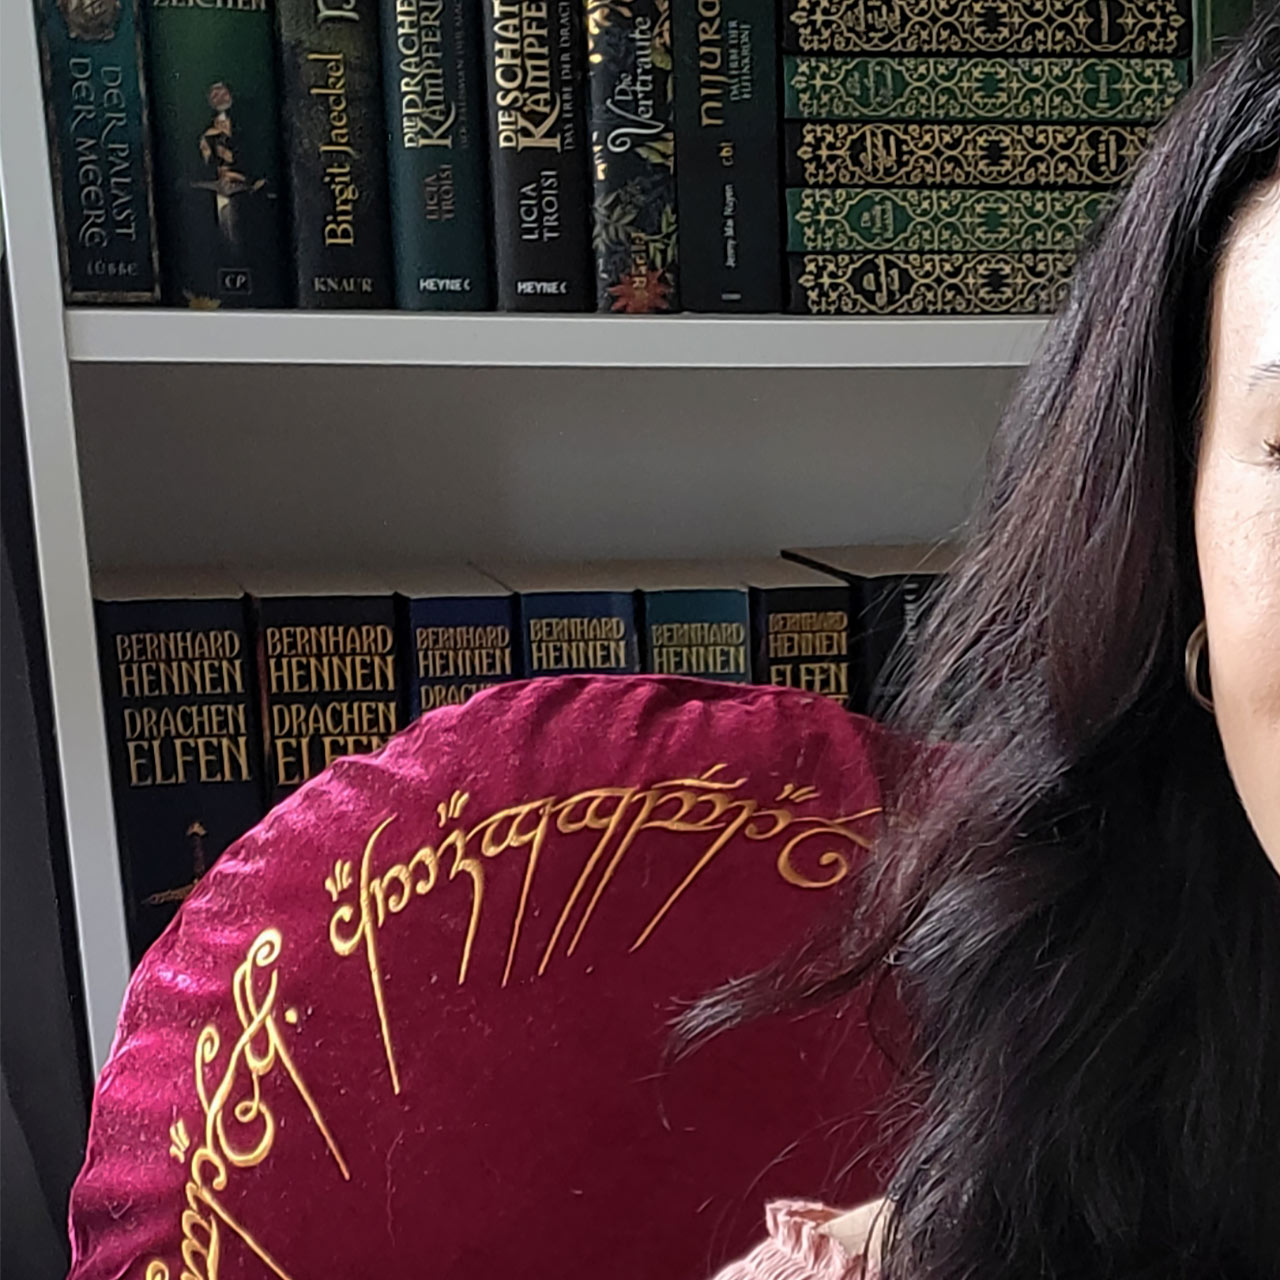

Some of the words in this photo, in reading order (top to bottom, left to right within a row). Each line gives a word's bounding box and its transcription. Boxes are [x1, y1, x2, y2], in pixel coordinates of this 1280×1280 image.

[69, 56, 98, 134] DER
[606, 16, 665, 153] Vertraute
[612, 74, 634, 101] Die
[100, 65, 128, 143] DER
[307, 52, 359, 159] Jaeckel
[498, 110, 517, 148] DIE
[75, 136, 109, 248] MEERE
[107, 143, 137, 241] PALAST
[323, 162, 359, 247] Birgit
[424, 174, 440, 220] LICIA
[439, 164, 455, 222] TROISI
[540, 170, 561, 242] TROISI
[519, 182, 540, 241] LICIA
[314, 277, 373, 293] KNAUR
[419, 278, 462, 291] HEYNE
[517, 281, 559, 294] HEYNE
[266, 624, 394, 656] BERNHARD
[416, 625, 511, 650] BERNHARD
[529, 617, 626, 642] BERNHARD
[651, 622, 745, 647] BERNHARD
[768, 611, 848, 634] BERNHARD
[116, 630, 240, 662] BERNHARD
[418, 648, 513, 678] HENNEN
[530, 639, 627, 671] HENNEN
[653, 645, 746, 675] HENNEN
[768, 631, 848, 659] HENNEN
[118, 658, 245, 698] HENNEN
[268, 654, 396, 694] HENNEN
[123, 703, 247, 739] DRACHEN
[271, 701, 398, 737] DRACHEN
[126, 735, 252, 786] ELFEN
